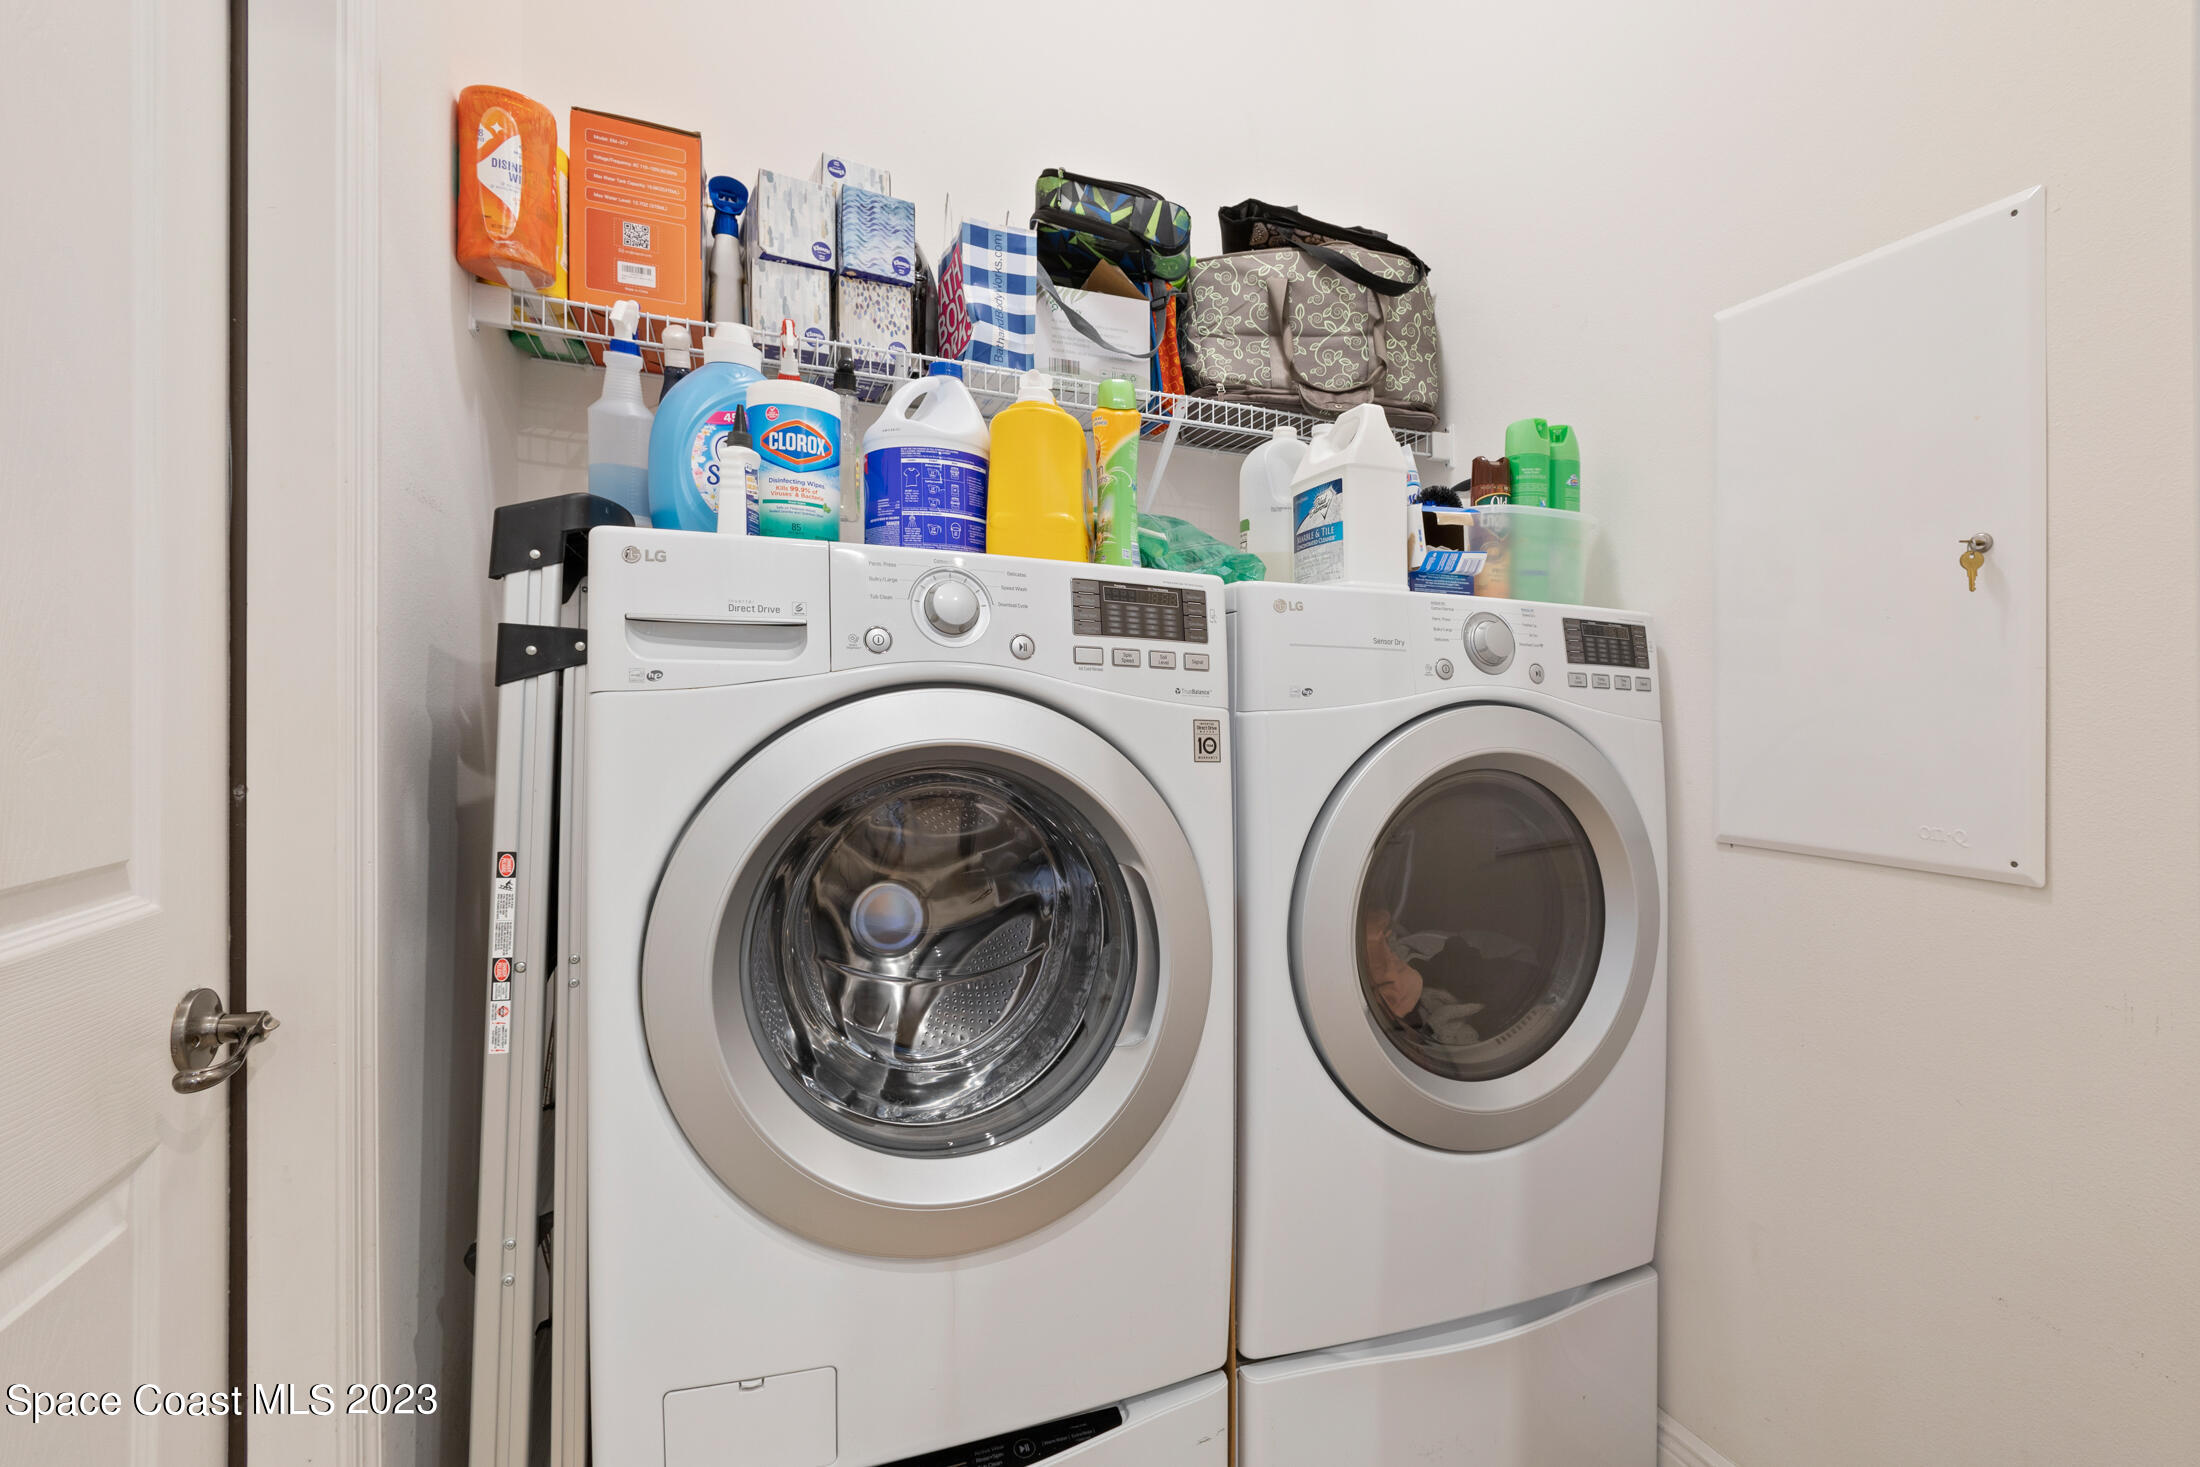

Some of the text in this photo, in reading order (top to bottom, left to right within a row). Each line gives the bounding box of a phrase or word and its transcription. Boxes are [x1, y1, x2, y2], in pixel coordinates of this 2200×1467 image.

[994, 234, 1005, 363] BathandBodyWorks.com
[768, 432, 826, 456] CLOROX
[768, 477, 825, 489] Disinfecting Wipes
[792, 523, 802, 531] 85
[1321, 526, 1334, 536] TILE
[645, 550, 667, 562] LG
[728, 604, 780, 614] Direct Drive
[1289, 602, 1304, 611] LG
[1198, 737, 1217, 754] 10
